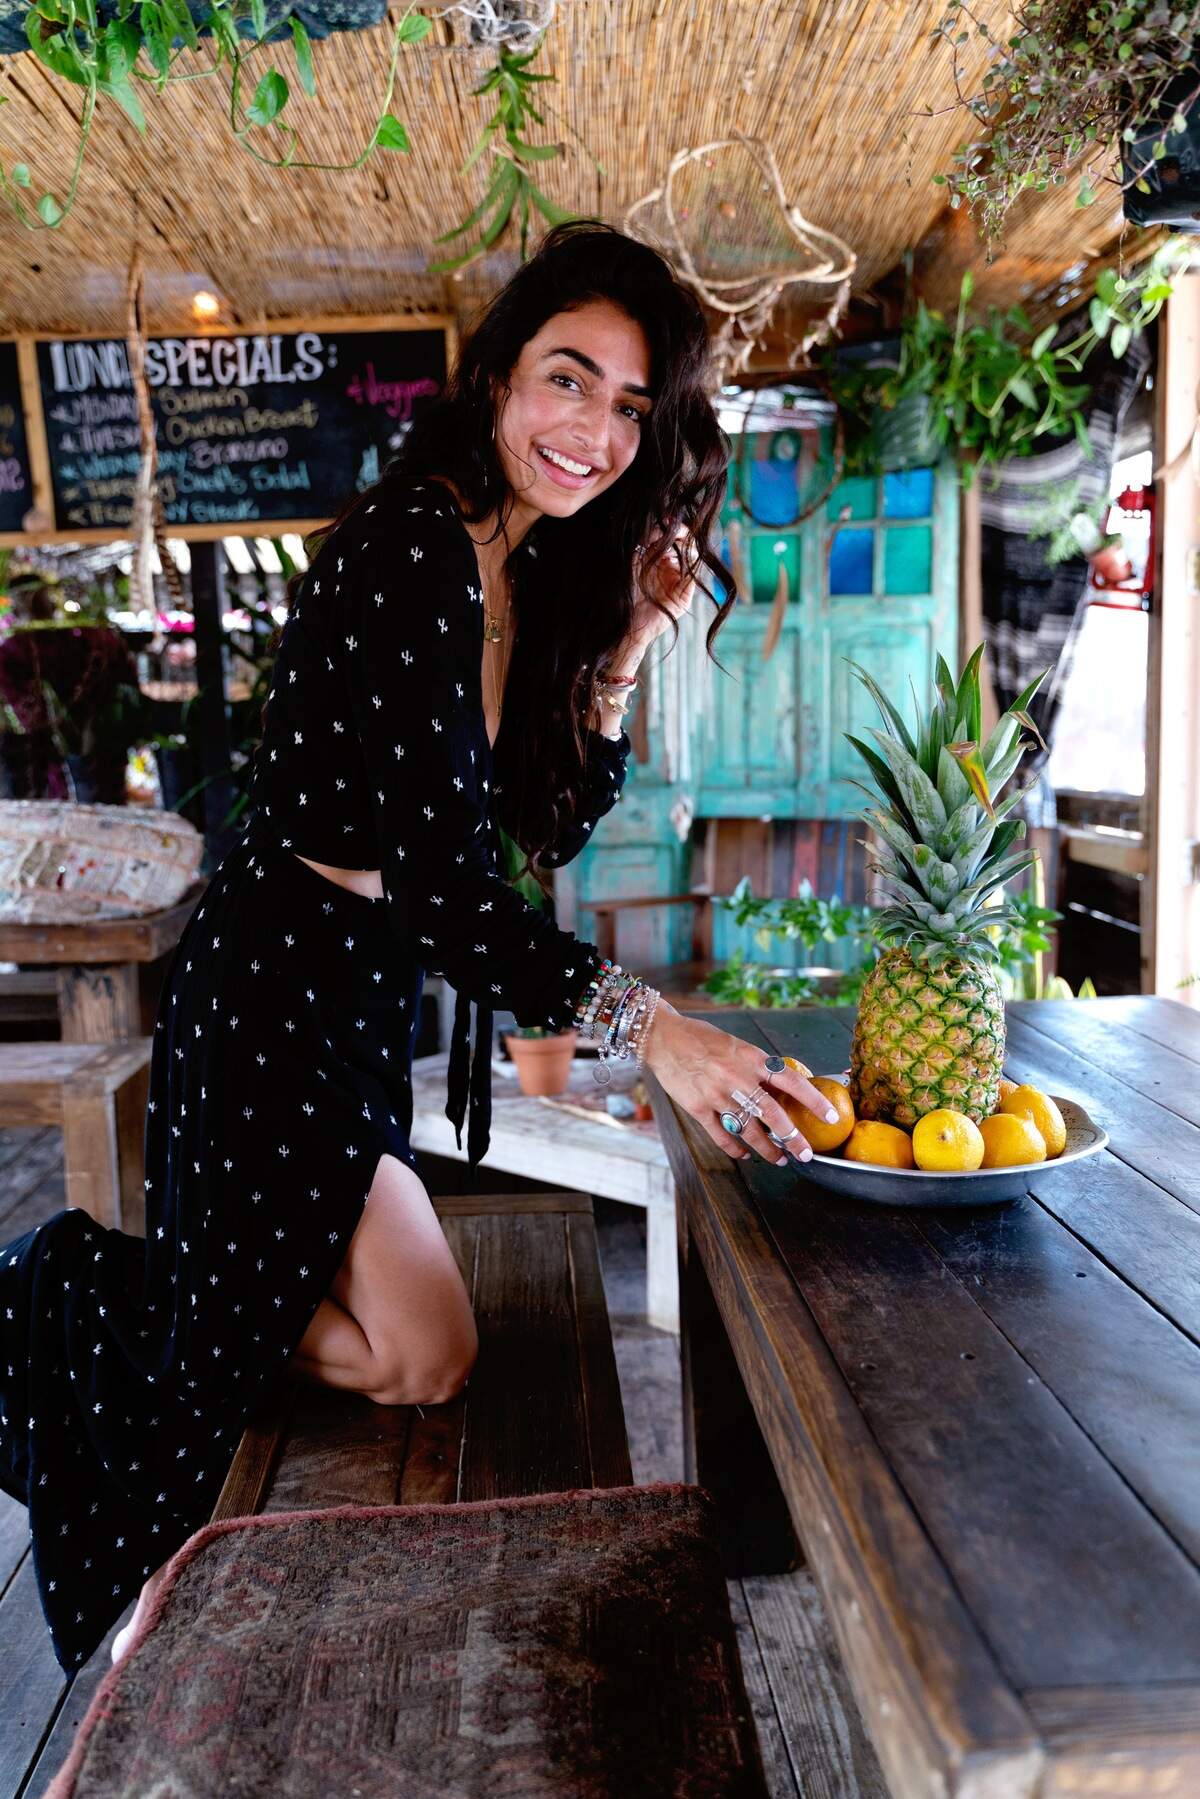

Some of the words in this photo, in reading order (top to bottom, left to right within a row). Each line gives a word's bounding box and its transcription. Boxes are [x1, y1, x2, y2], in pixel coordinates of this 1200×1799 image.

[158, 387, 249, 416] Salmon
[243, 405, 319, 433] Breast
[251, 459, 312, 491] Salad
[190, 499, 261, 522] Steak
